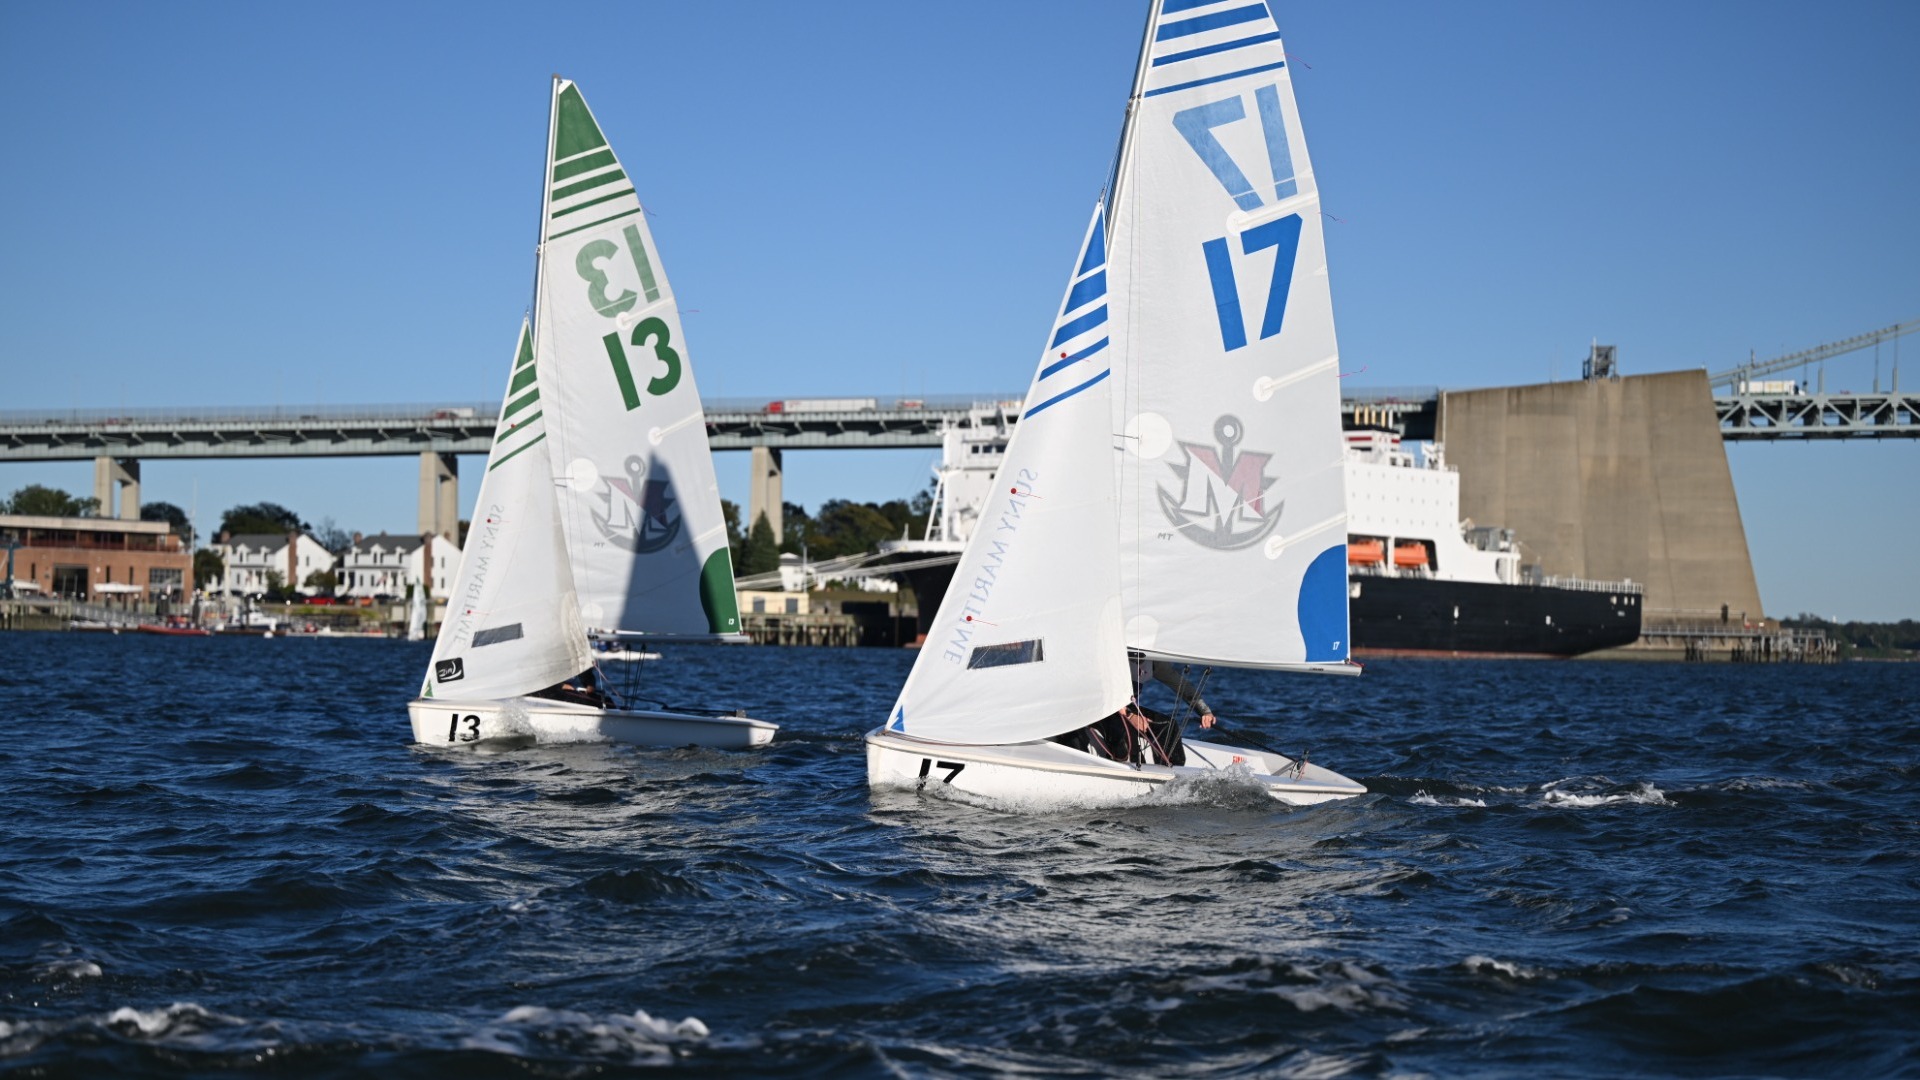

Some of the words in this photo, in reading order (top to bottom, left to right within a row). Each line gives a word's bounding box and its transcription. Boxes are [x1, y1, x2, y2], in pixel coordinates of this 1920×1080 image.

[1202, 213, 1303, 352] 17
[602, 317, 681, 411] 13
[1332, 641, 1341, 651] 17
[448, 713, 480, 742] 13
[916, 758, 965, 790] 17
